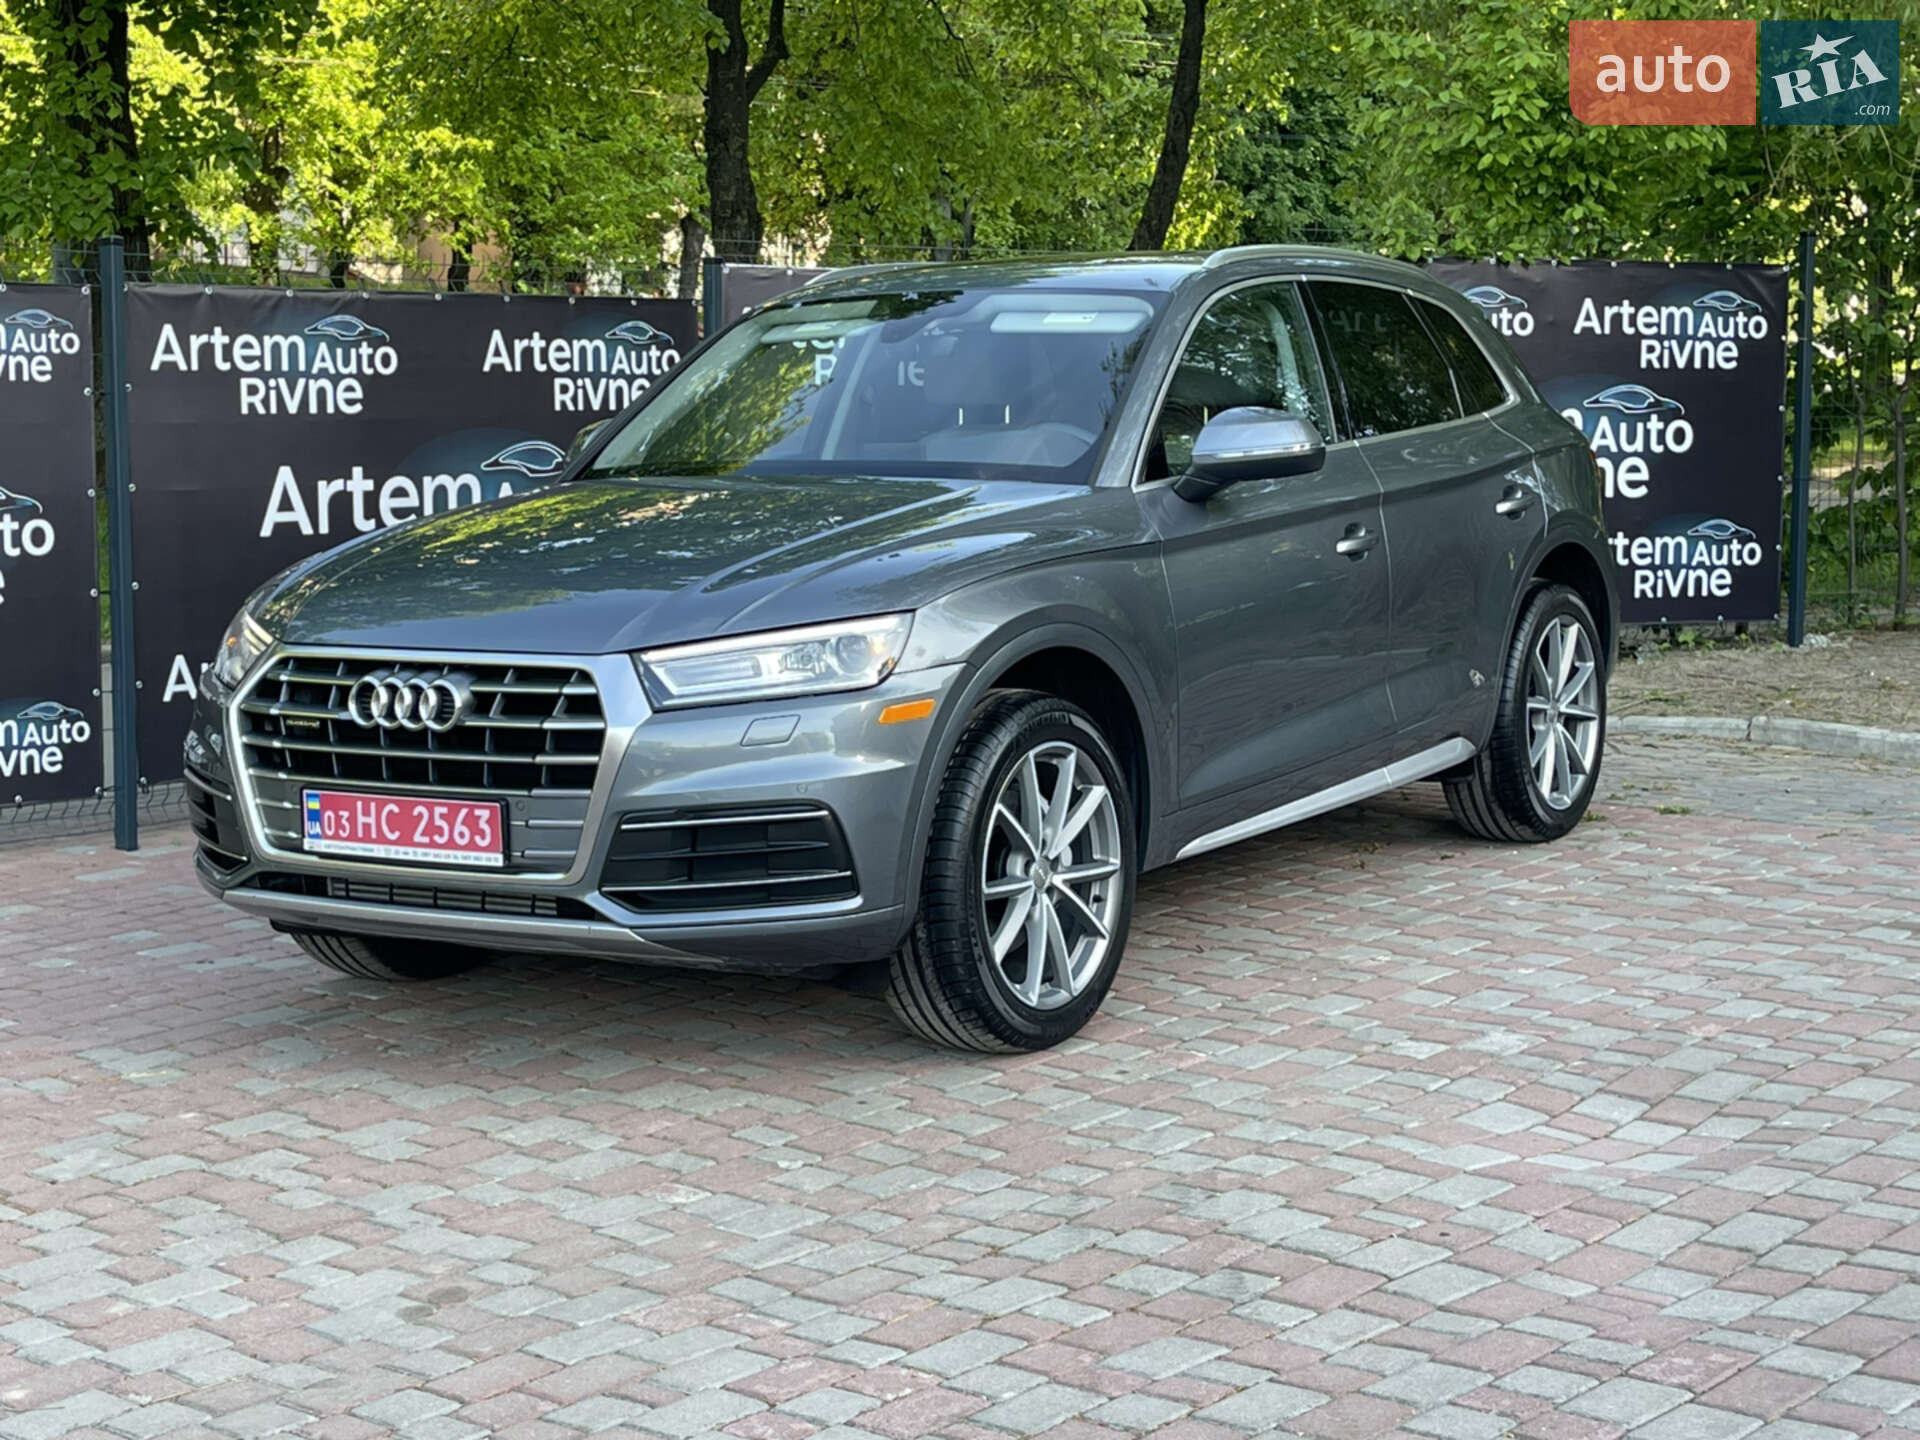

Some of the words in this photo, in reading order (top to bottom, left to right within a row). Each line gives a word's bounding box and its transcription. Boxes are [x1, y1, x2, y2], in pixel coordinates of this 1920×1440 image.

[1491, 307, 1534, 336] to
[1573, 298, 1693, 335] Artem
[1696, 311, 1768, 339] Auto
[11, 328, 81, 354] Auto
[150, 323, 305, 372] Artem
[311, 342, 399, 375] Auto
[482, 329, 608, 372] Artem
[1590, 413, 1694, 454] Auto
[259, 465, 482, 538] Artem
[0, 513, 55, 557] to
[1607, 530, 1688, 567] tem
[1691, 542, 1762, 567] Auto
[22, 719, 91, 746] Auto
[308, 821, 321, 836] UA
[412, 806, 492, 847] 2563
